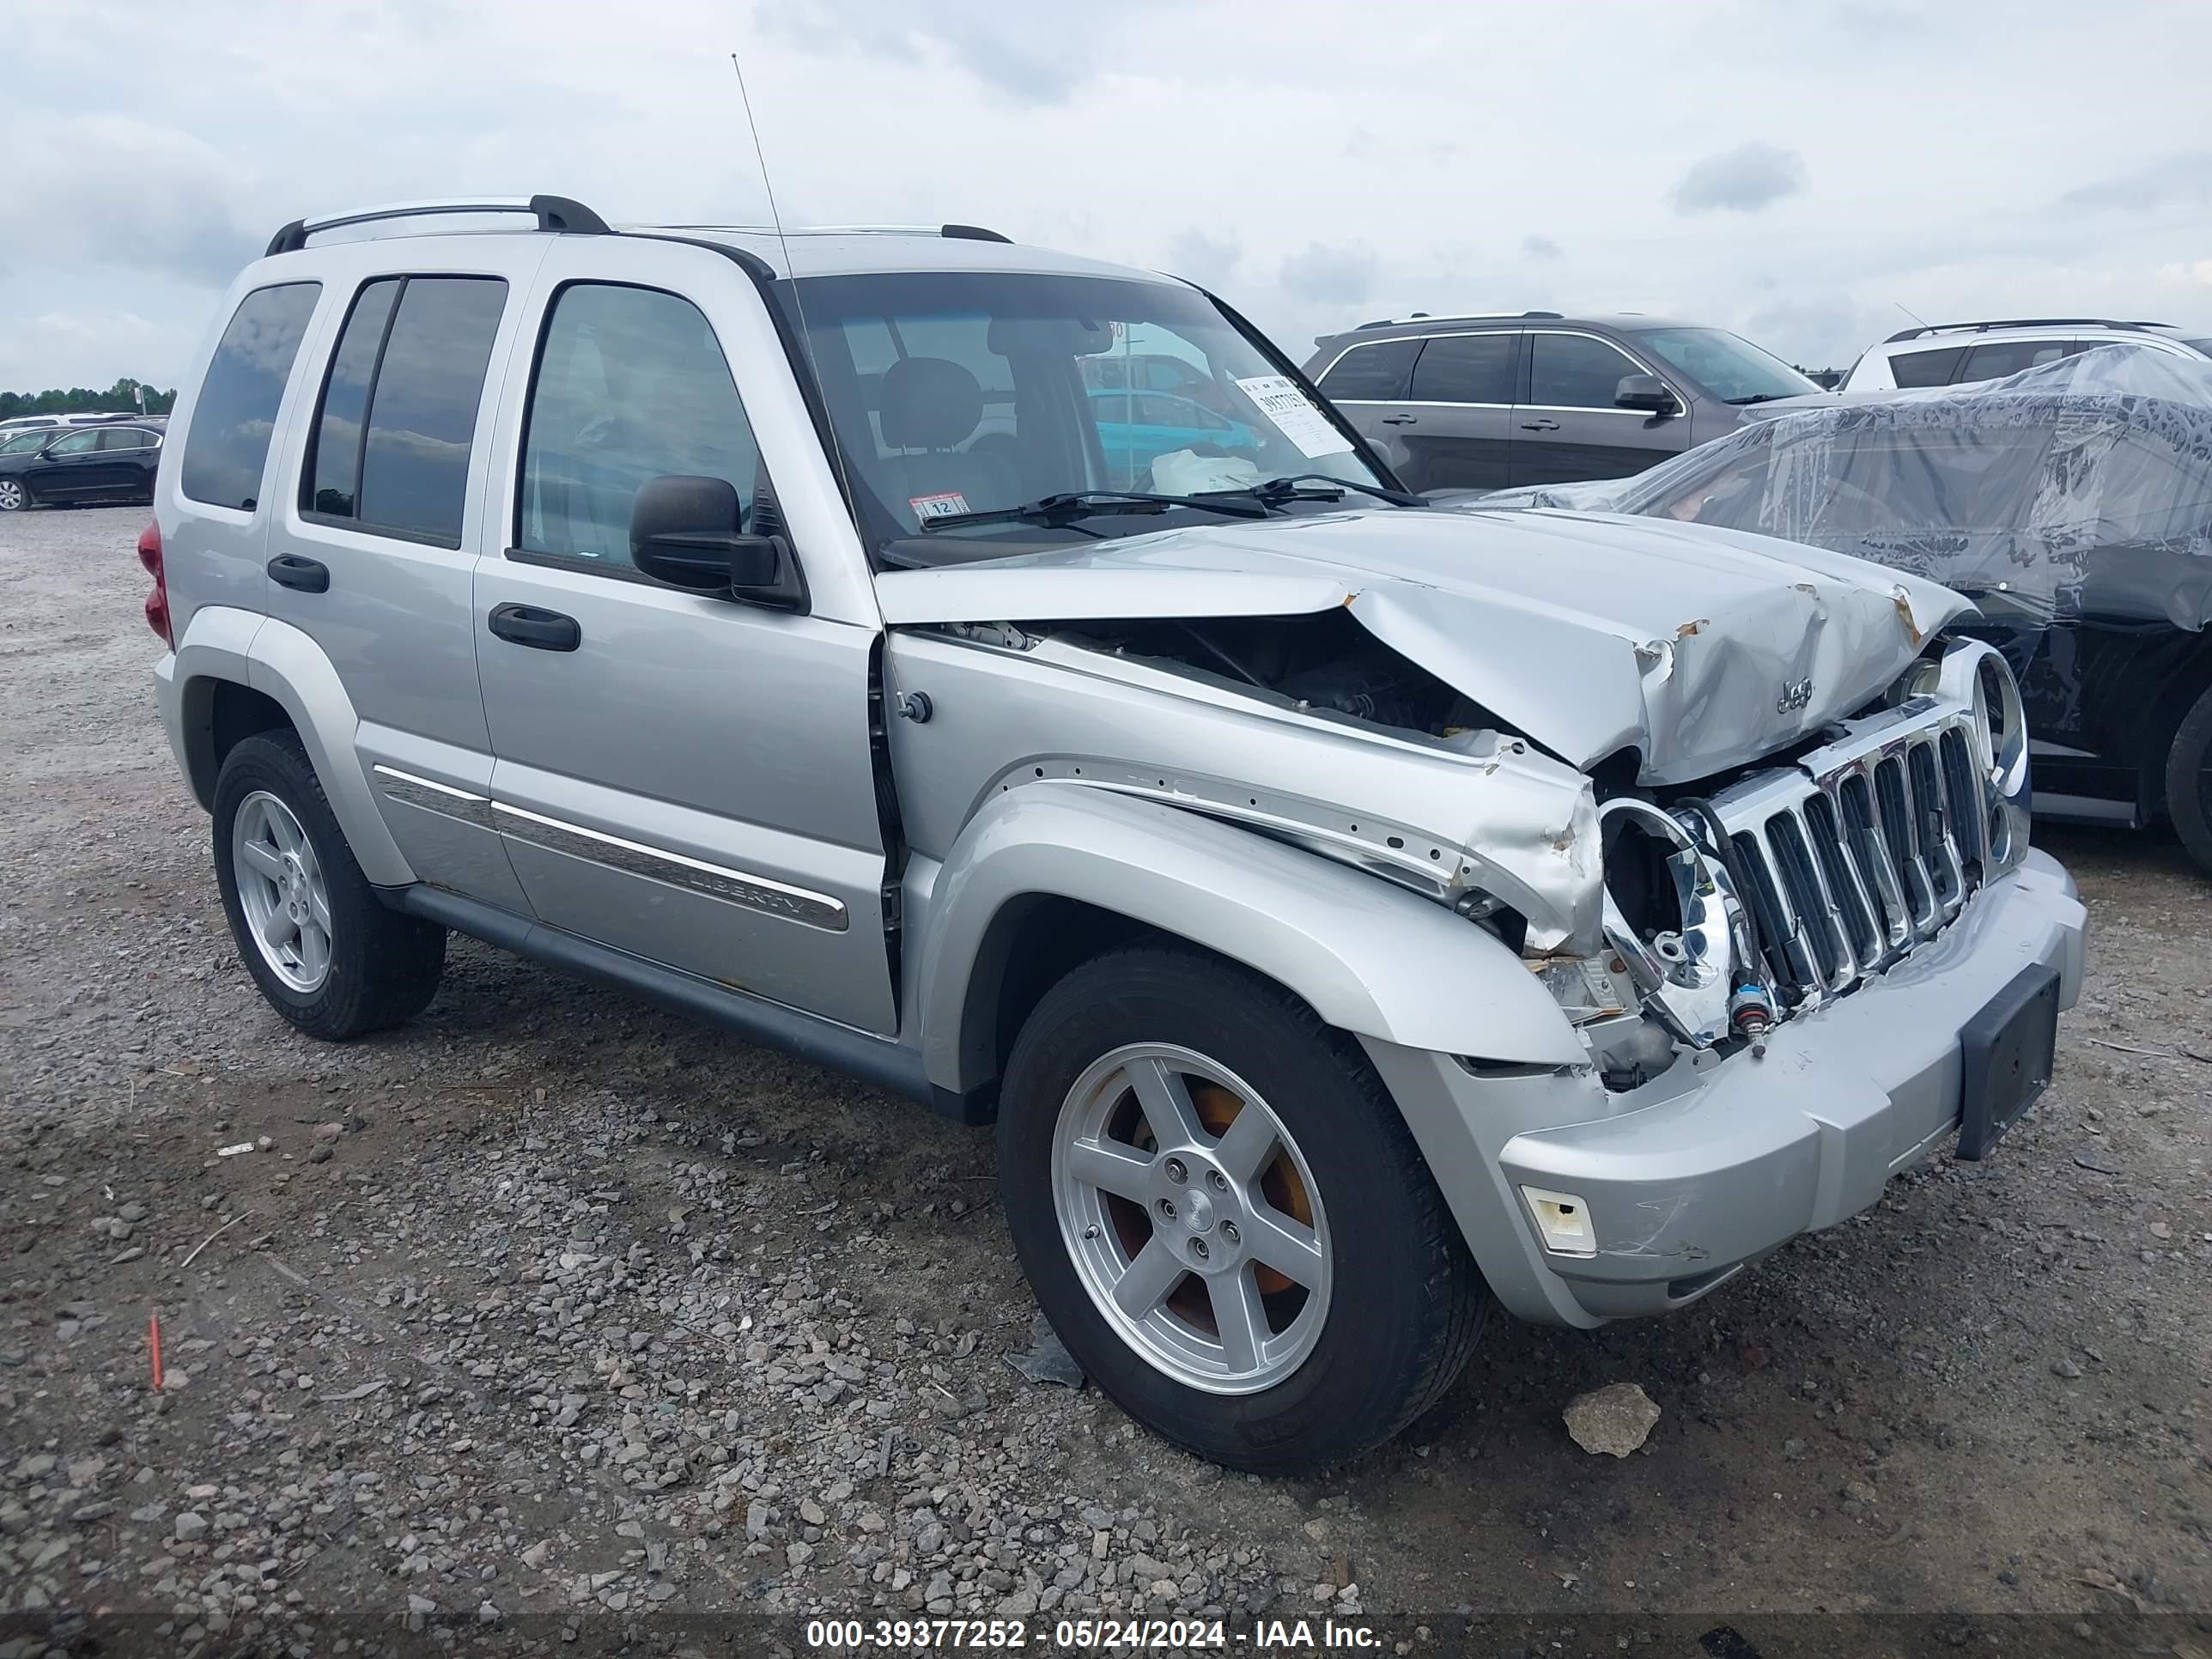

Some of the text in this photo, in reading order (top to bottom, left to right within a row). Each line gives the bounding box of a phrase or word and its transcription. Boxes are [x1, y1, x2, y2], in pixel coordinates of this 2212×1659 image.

[933, 502, 951, 514] 12
[1778, 678, 1812, 714] Jeep
[690, 874, 805, 914] LIBERTY
